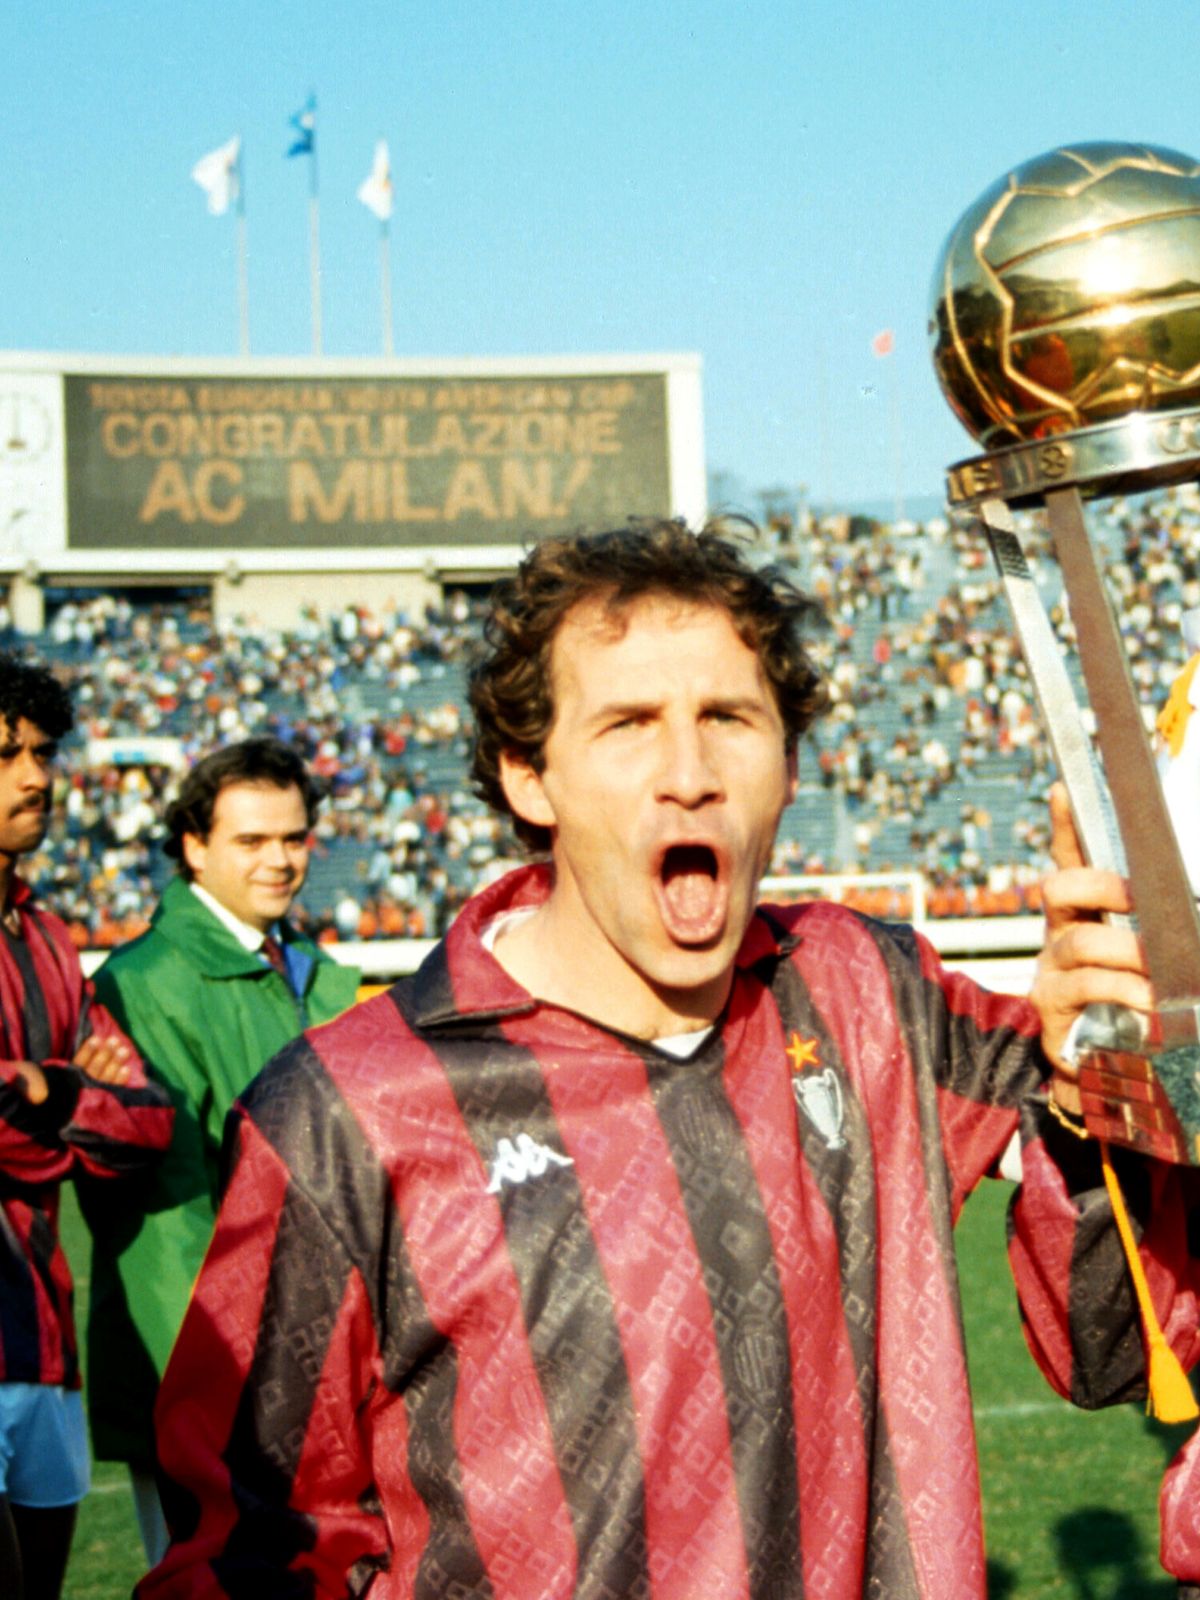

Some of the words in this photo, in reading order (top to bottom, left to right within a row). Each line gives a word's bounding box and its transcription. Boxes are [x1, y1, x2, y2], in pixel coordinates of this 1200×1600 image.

[101, 411, 623, 459] CONGRATULAZIONE
[138, 458, 247, 525] AC
[288, 456, 594, 524] MILAN!
